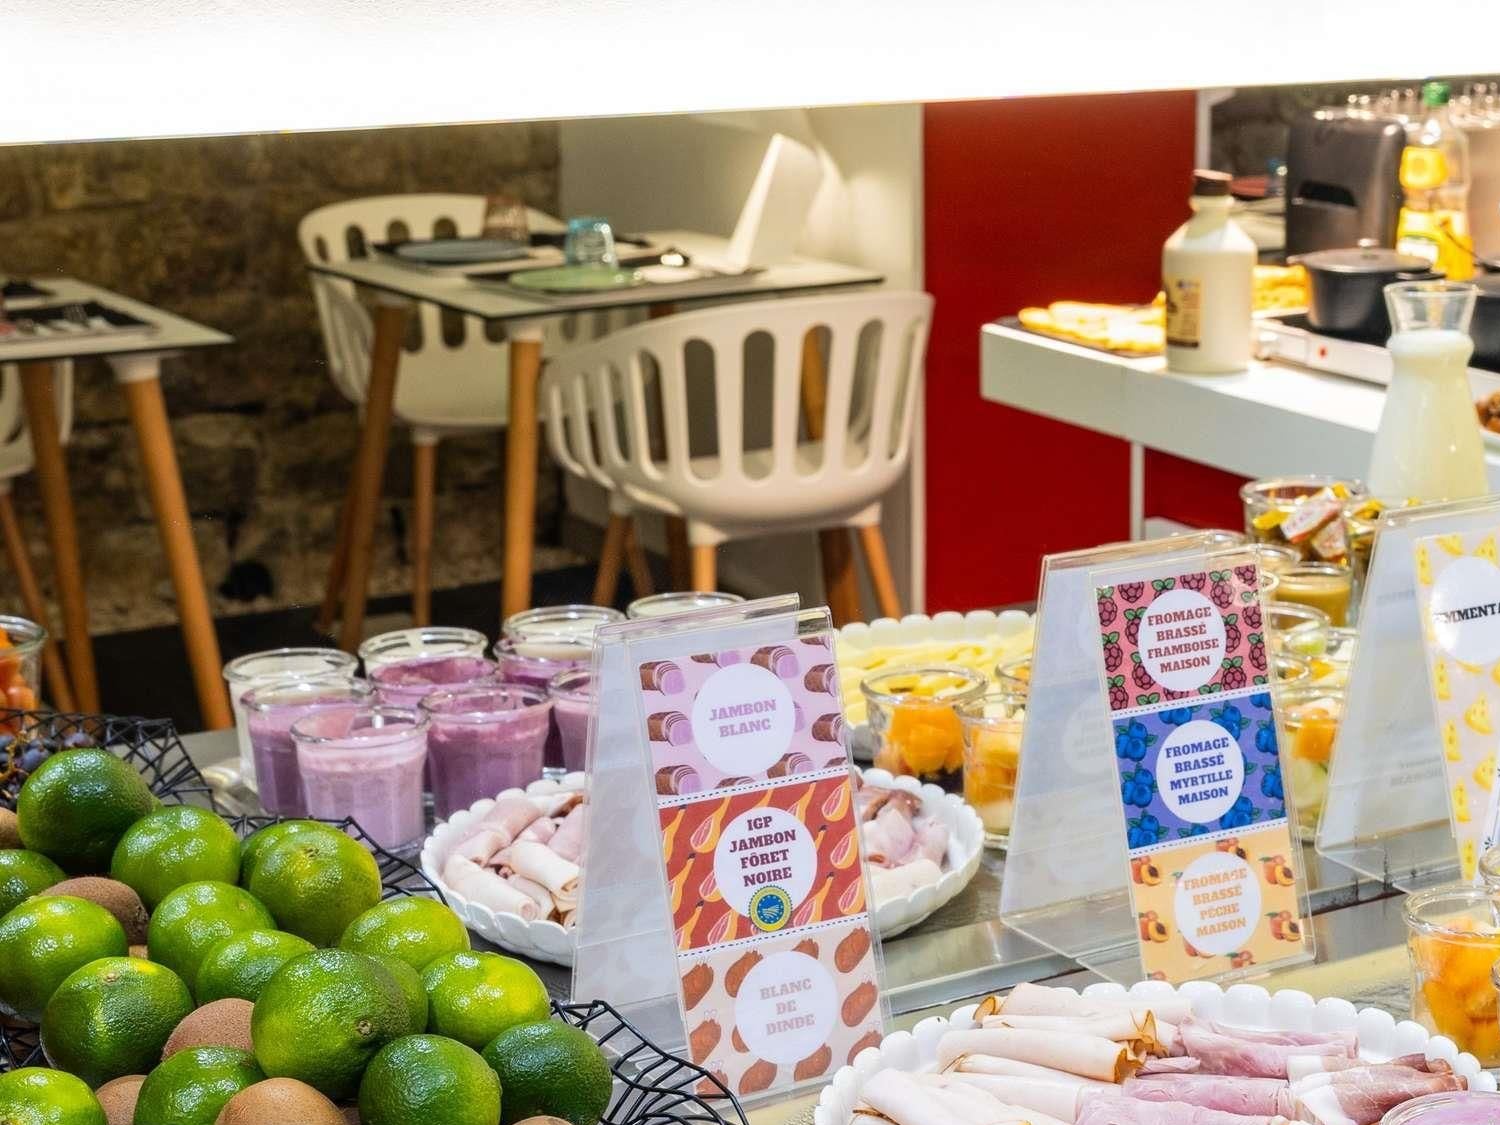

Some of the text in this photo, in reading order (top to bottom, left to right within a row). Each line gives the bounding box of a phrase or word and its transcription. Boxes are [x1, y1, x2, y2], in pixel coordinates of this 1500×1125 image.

[1147, 606, 1212, 626] FROMAGE
[1147, 638, 1219, 659] FRAMBOISE
[1160, 655, 1210, 673] MAISON
[709, 699, 776, 721] JAMBON
[719, 718, 771, 738] BLANC
[1165, 737, 1229, 758] FROMAGE
[1170, 769, 1233, 791] MYRTILLE
[1178, 786, 1228, 805] MAISON
[747, 815, 773, 831] IGP
[729, 829, 797, 853] JAMBON
[740, 848, 789, 869] FÔRET
[743, 866, 792, 887] NOIRE
[1184, 867, 1248, 890] FROMAGE
[1196, 916, 1246, 937] MAISON
[760, 978, 812, 1000] BLANC
[776, 999, 797, 1015] DE
[766, 1013, 815, 1035] DINDE
